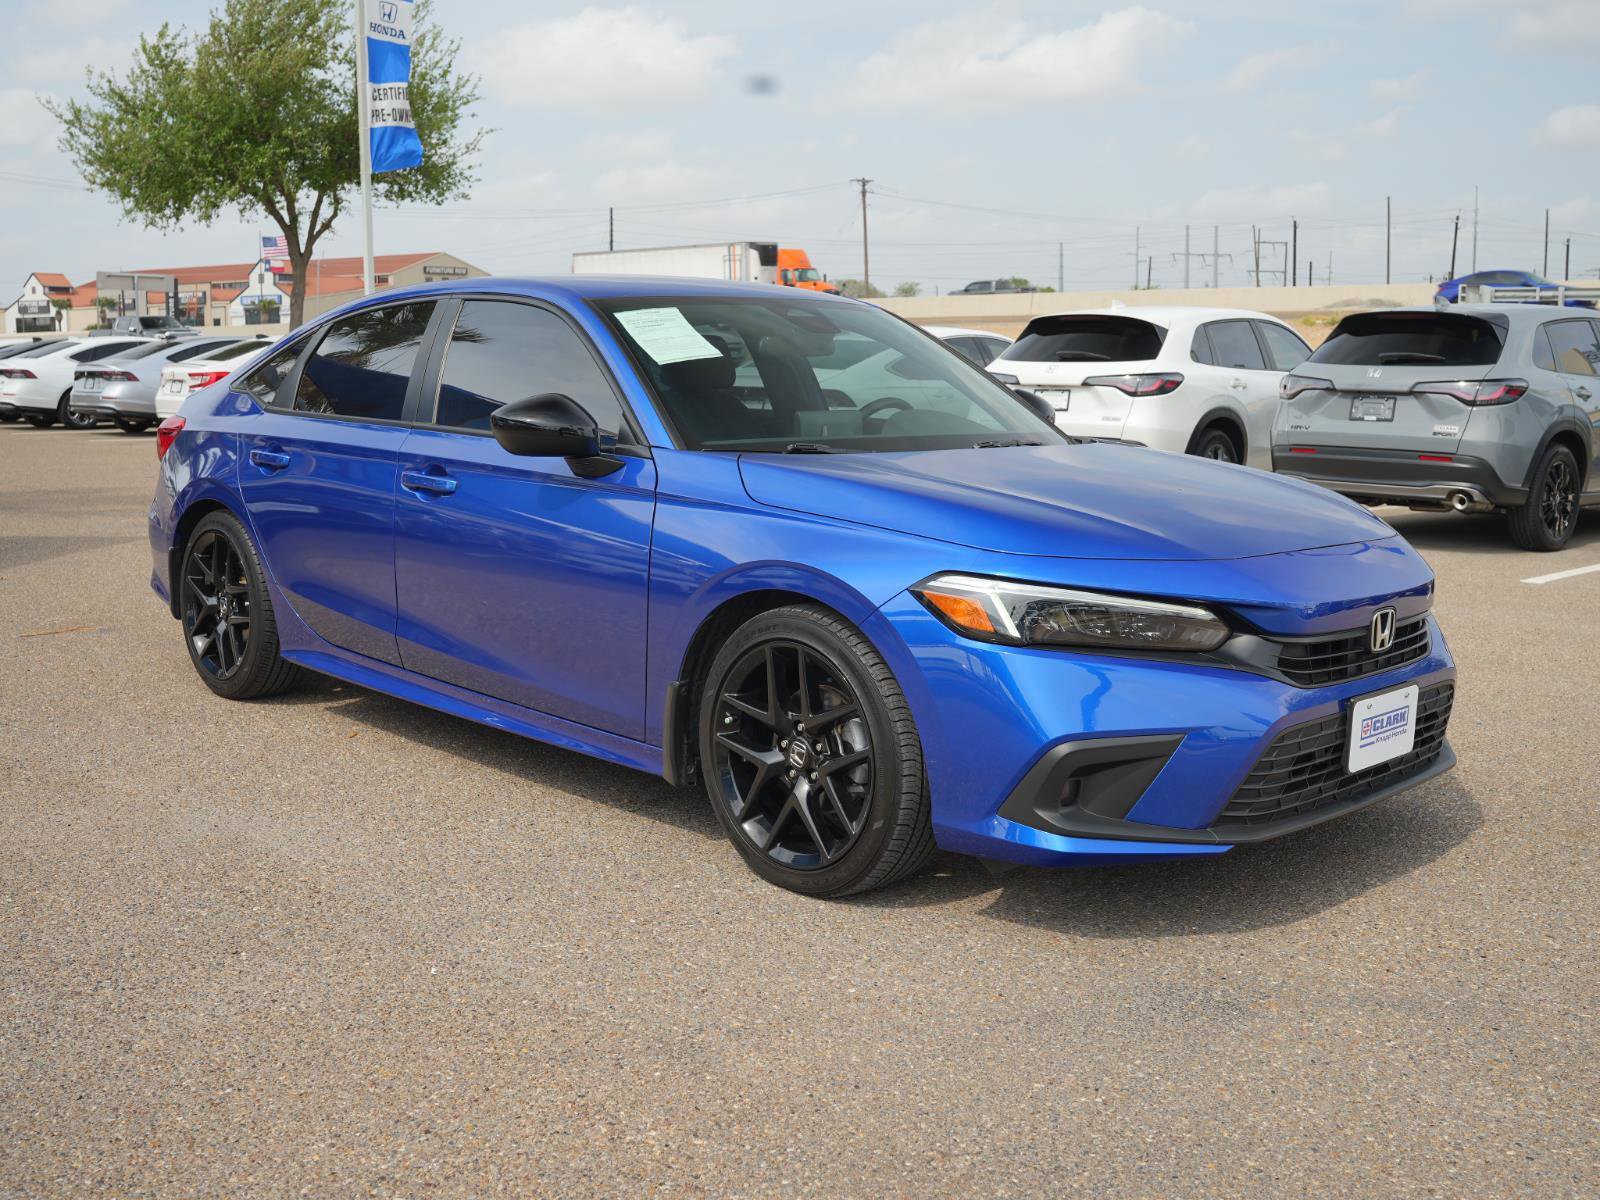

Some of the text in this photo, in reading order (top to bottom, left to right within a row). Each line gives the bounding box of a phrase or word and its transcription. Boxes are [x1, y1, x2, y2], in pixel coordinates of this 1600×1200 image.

[369, 22, 406, 39] HONDA
[371, 108, 411, 122] PRE-OWN
[1372, 710, 1407, 732] CLARK
[1392, 728, 1407, 738] Honda
